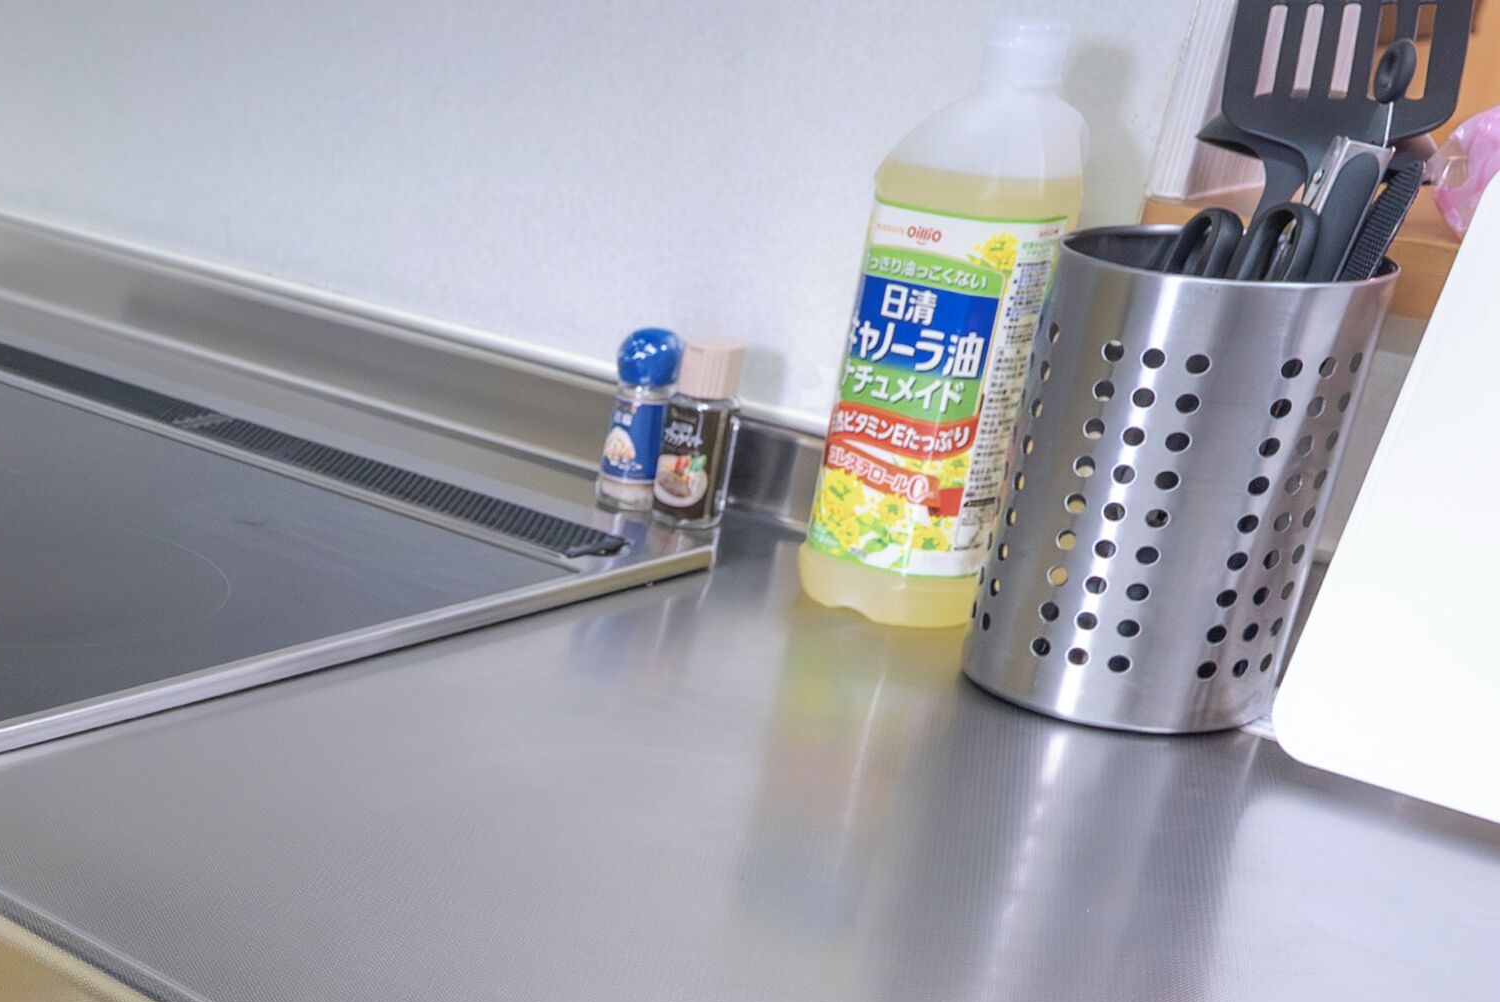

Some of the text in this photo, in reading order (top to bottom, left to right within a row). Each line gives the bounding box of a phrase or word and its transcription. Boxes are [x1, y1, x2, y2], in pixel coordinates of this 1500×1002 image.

[868, 254, 988, 289] っきり油っこくない
[880, 283, 938, 326] 日清
